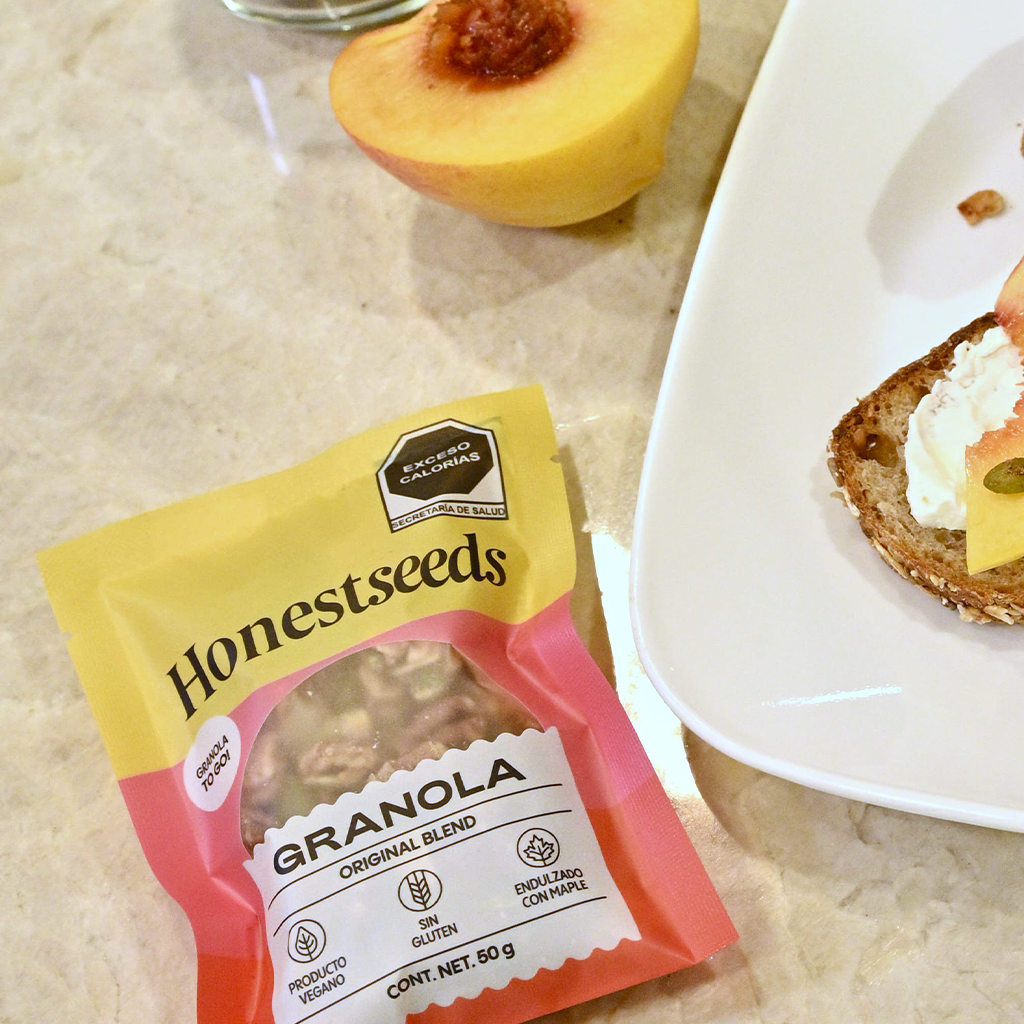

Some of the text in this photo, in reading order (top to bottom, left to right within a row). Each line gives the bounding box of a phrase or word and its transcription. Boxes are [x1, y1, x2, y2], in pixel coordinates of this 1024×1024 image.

[400, 451, 481, 484] CALORÍAS
[403, 442, 470, 473] EXCESO
[392, 504, 505, 529] SECRETARÍA DE SALUD
[166, 533, 507, 722] Honestseeds
[196, 735, 229, 779] GRANOLA
[201, 749, 231, 792] TO GO!
[273, 758, 527, 875] GRANOLA
[339, 815, 476, 879] ORIGINAL BLEND
[514, 867, 583, 896] ENDULZADO
[521, 879, 588, 908] CON MAPLE
[411, 922, 458, 949] GLUTEN
[418, 914, 439, 930] SIN
[288, 956, 347, 995] PRODUCTO
[386, 942, 515, 999] CONT. NET. 50 g
[298, 973, 346, 1005] VEGANO
